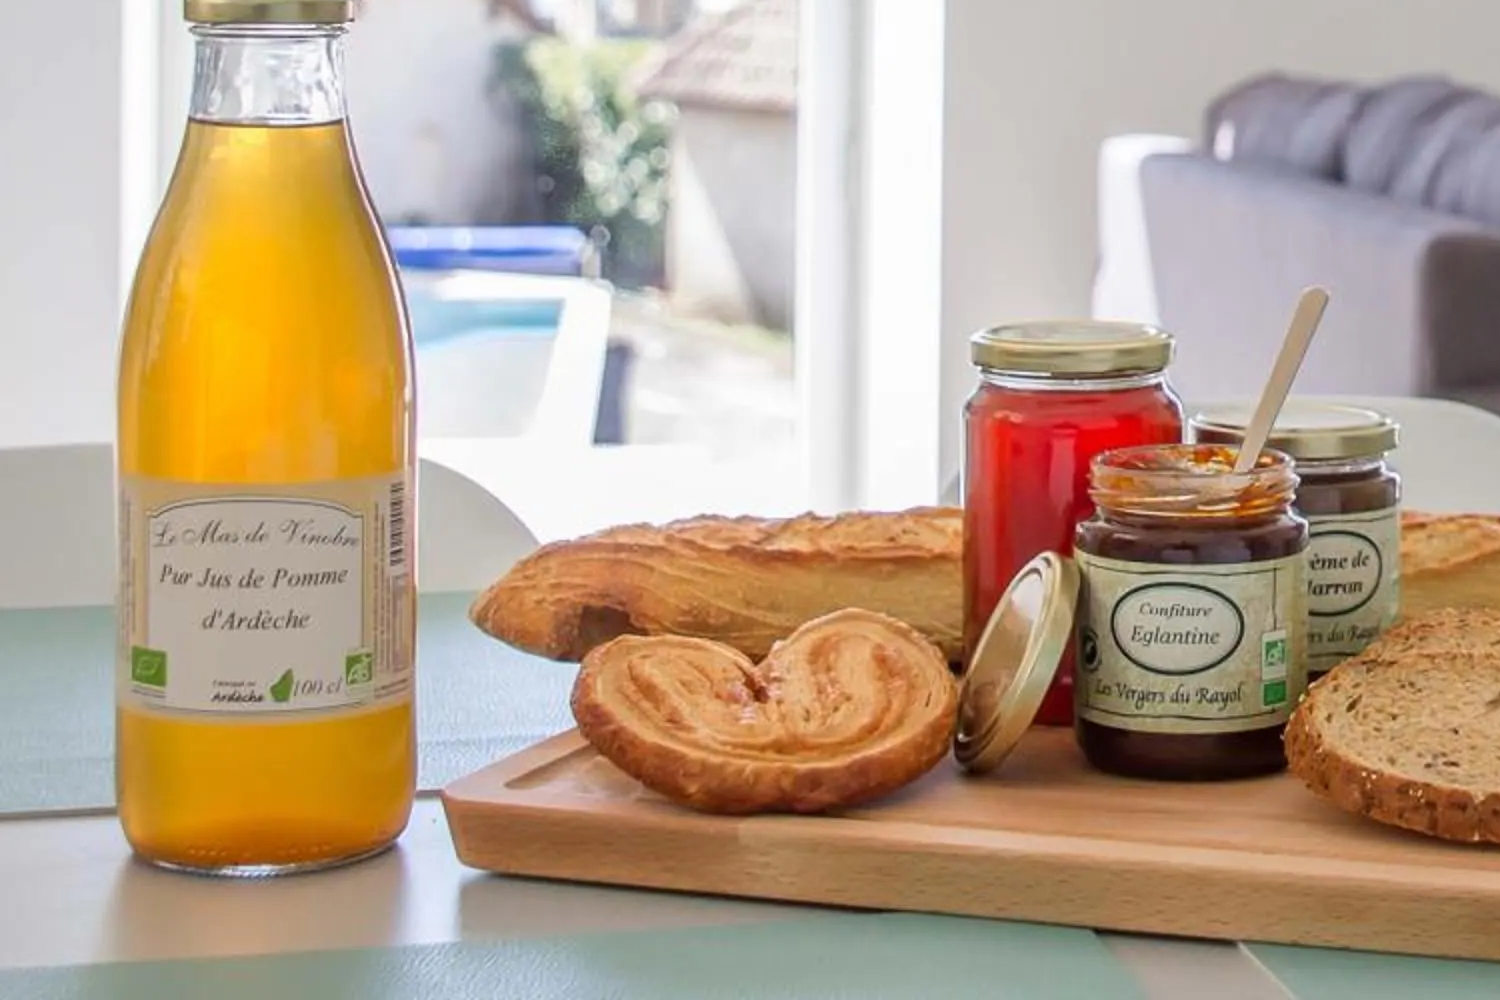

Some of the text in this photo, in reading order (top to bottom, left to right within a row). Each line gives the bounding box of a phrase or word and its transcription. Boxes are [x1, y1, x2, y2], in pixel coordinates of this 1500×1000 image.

[182, 518, 240, 546] Mas
[245, 521, 269, 544] de
[1308, 550, 1371, 570] ème de
[159, 563, 349, 589] Pur Jus de Pomme
[1307, 580, 1364, 596] arron
[201, 608, 311, 631] d'Ardèche
[1139, 602, 1214, 619] Confiture
[1130, 626, 1221, 645] Eglantine
[293, 677, 343, 697] 100 cl
[1115, 682, 1165, 710] Vergers
[1169, 684, 1191, 704] du
[1195, 680, 1244, 711] Rayol
